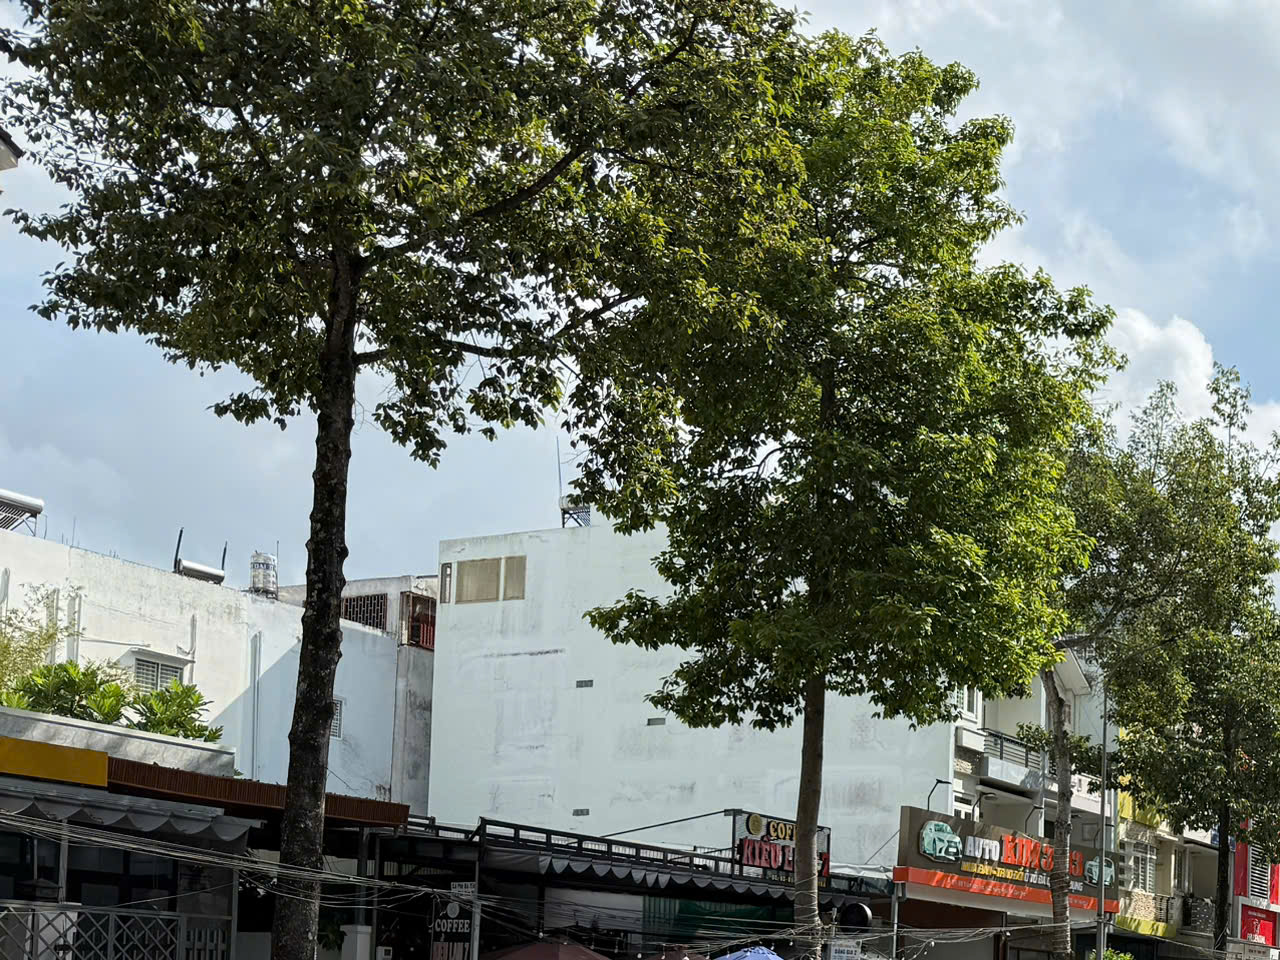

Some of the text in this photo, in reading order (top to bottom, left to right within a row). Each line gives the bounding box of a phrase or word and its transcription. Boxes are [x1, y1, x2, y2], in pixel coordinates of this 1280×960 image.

[965, 835, 1000, 861] AUTO
[1000, 833, 1041, 870] KIM
[434, 919, 471, 933] COFFEE
